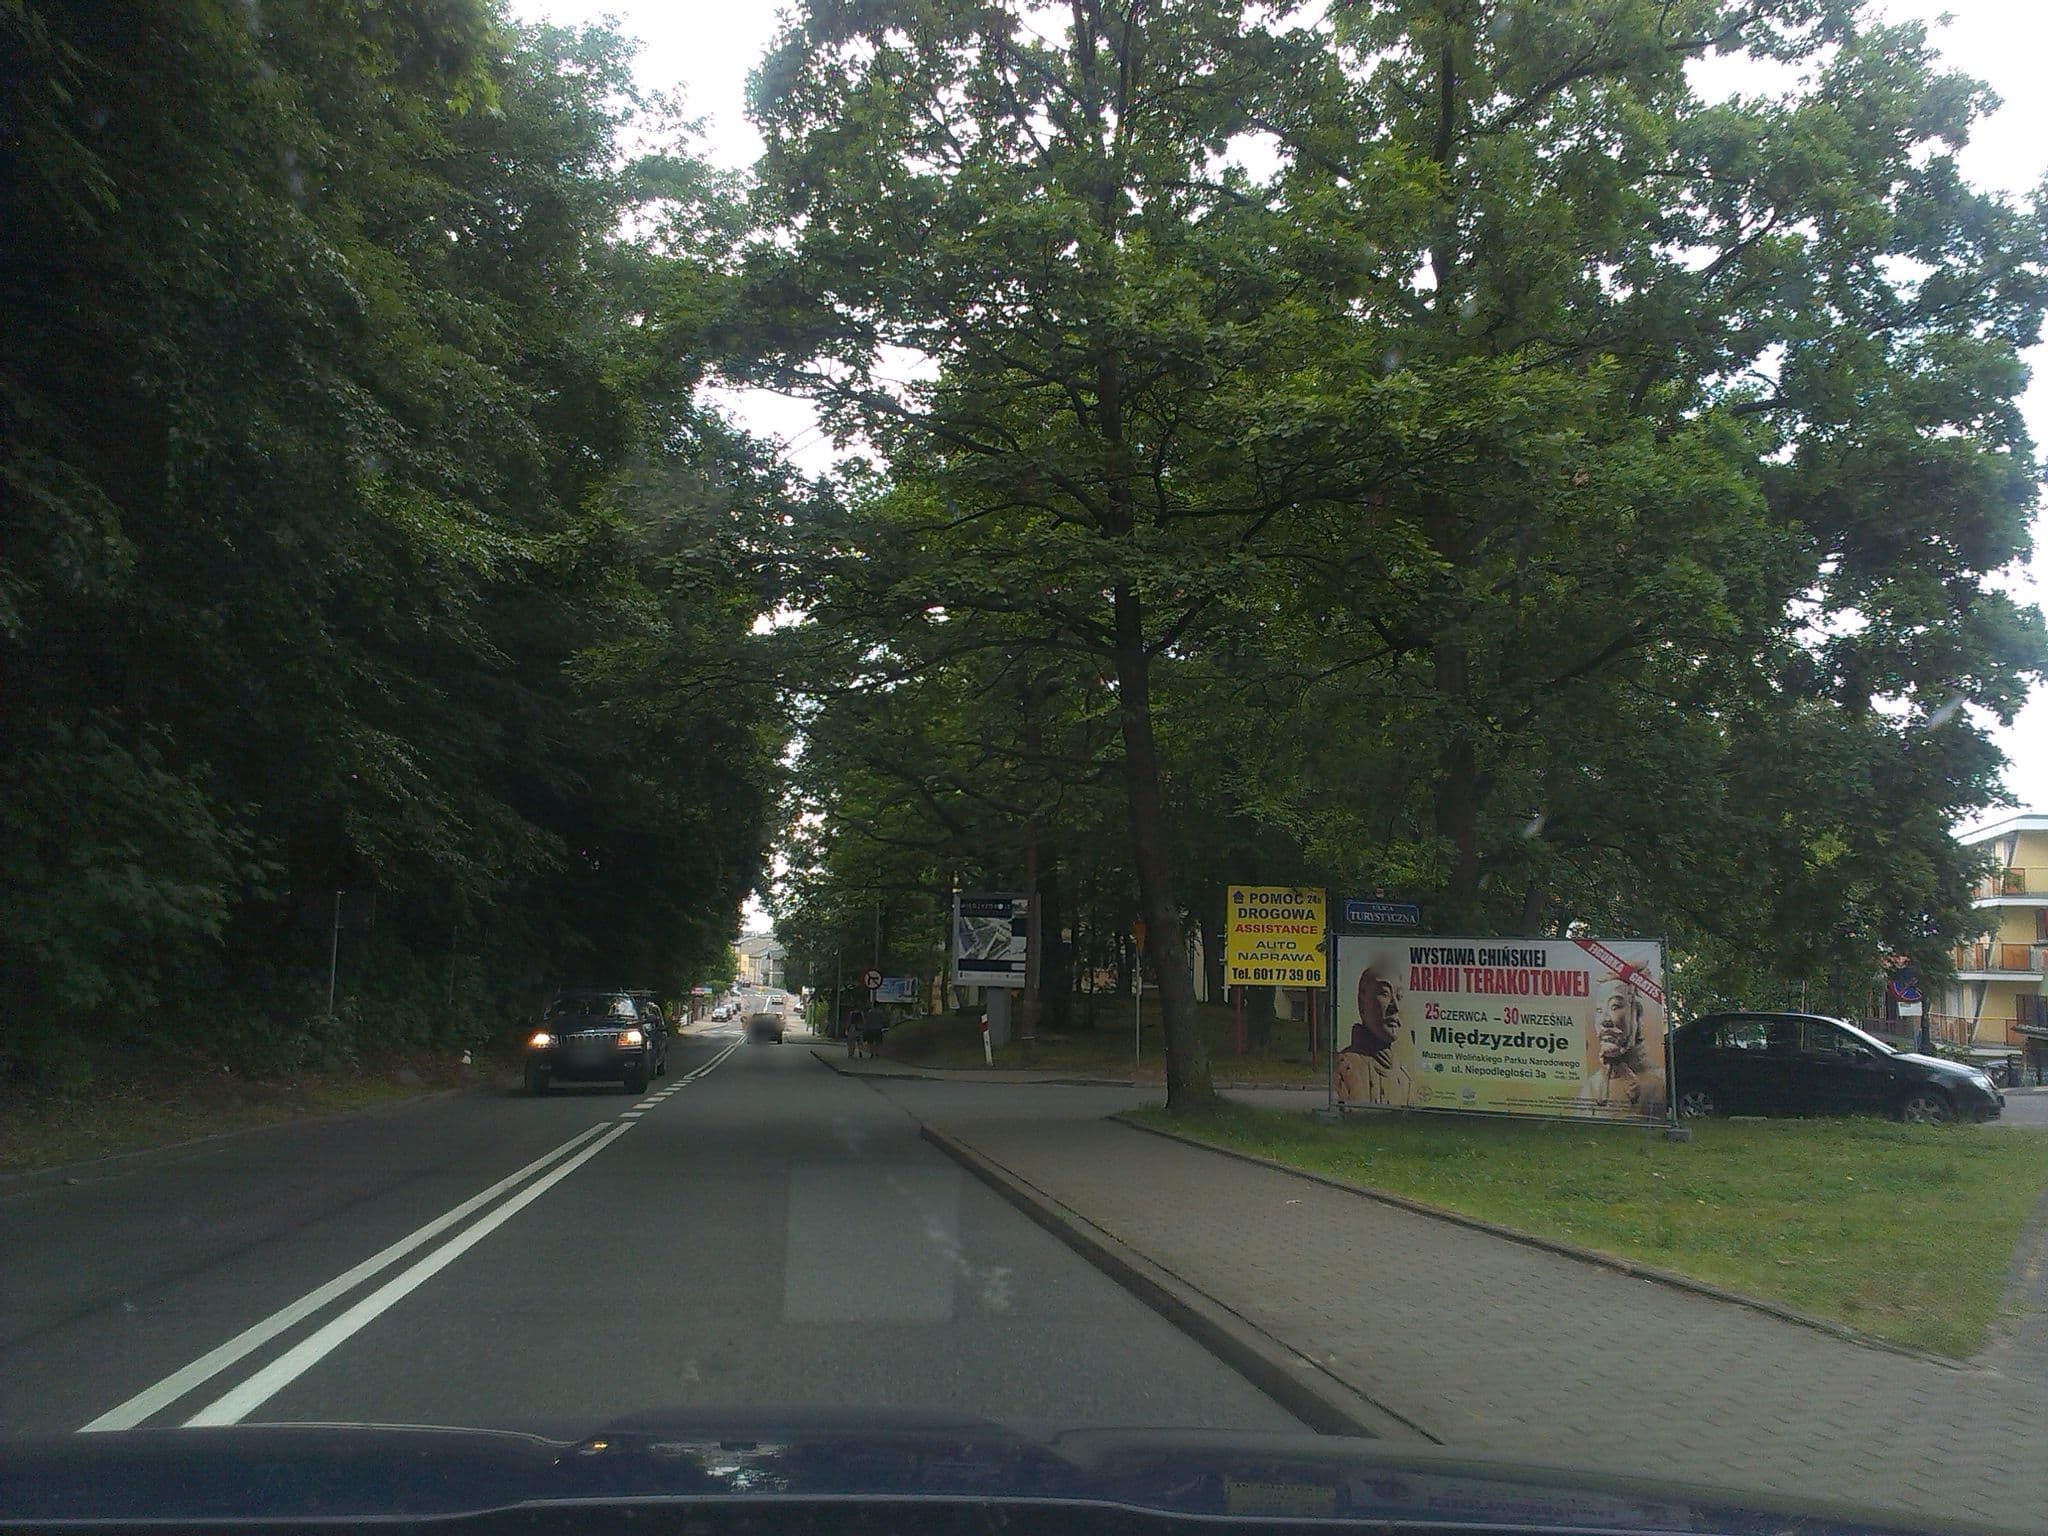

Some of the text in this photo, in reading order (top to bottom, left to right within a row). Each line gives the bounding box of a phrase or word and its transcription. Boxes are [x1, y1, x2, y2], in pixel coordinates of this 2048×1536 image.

[1249, 893, 1304, 905] POMOC
[1238, 908, 1316, 920] DROGOWA
[1350, 911, 1417, 925] TURYSTYCZNA
[1235, 924, 1318, 935] ASSISTANCE
[1256, 941, 1297, 950] AUTO
[1238, 952, 1315, 962] NAPRAWA
[1410, 946, 1546, 967] WYSTAWA CHIŃSKIEJ
[1588, 943, 1625, 973] FIGURKA
[1232, 968, 1321, 982] Tel. 601 77 39 06
[1410, 966, 1590, 997] ARMII TERAKOTOWEJ
[1629, 972, 1660, 997] GRATIS
[1504, 1007, 1519, 1025] 30
[1521, 1011, 1575, 1027] WRZEŚNIA
[1430, 1026, 1569, 1053] Międzyzdroje
[1422, 1050, 1580, 1069] Muzeum Wolińskiego Parku Narodowego
[1451, 1065, 1463, 1074] ul.
[1465, 1065, 1533, 1079] Niepodległości
[1535, 1070, 1547, 1079] 3a
